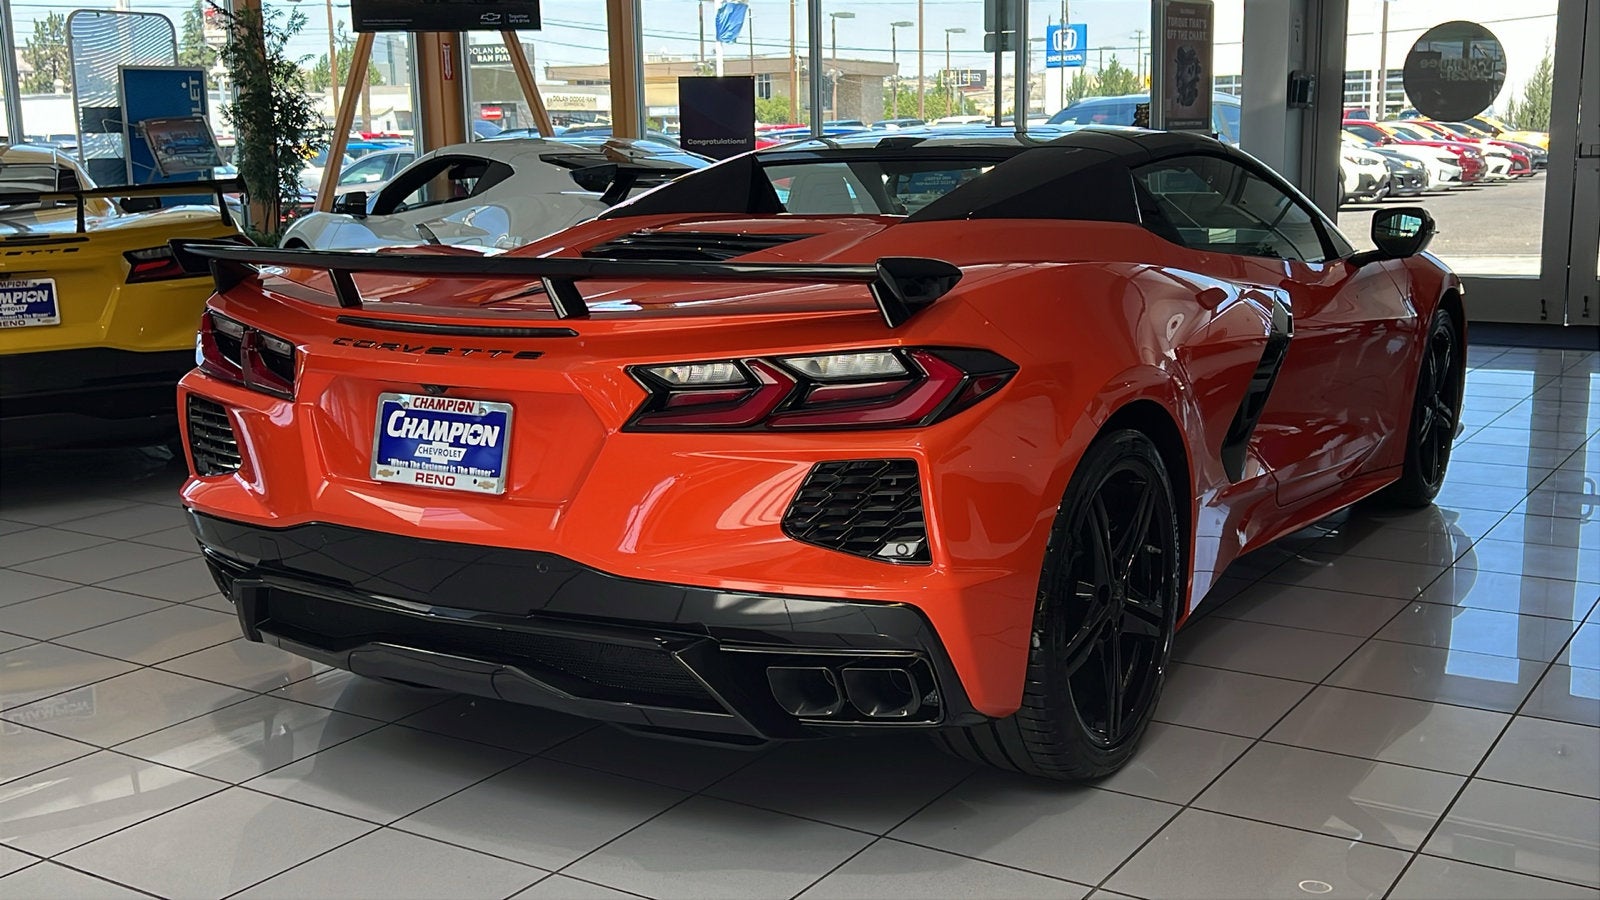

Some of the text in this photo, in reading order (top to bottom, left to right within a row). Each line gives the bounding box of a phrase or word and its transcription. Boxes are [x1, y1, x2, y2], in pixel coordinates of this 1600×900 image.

[477, 54, 493, 62] RAM
[1047, 54, 1082, 62] HONDA
[687, 138, 748, 146] Congratulations!
[332, 336, 546, 360] CORVETTE
[413, 397, 475, 413] CHAMPION
[387, 410, 500, 447] CHAMPION
[418, 446, 462, 459] CHEVROLET
[410, 460, 420, 470] The
[457, 465, 468, 474] The
[415, 472, 455, 487] RENO
